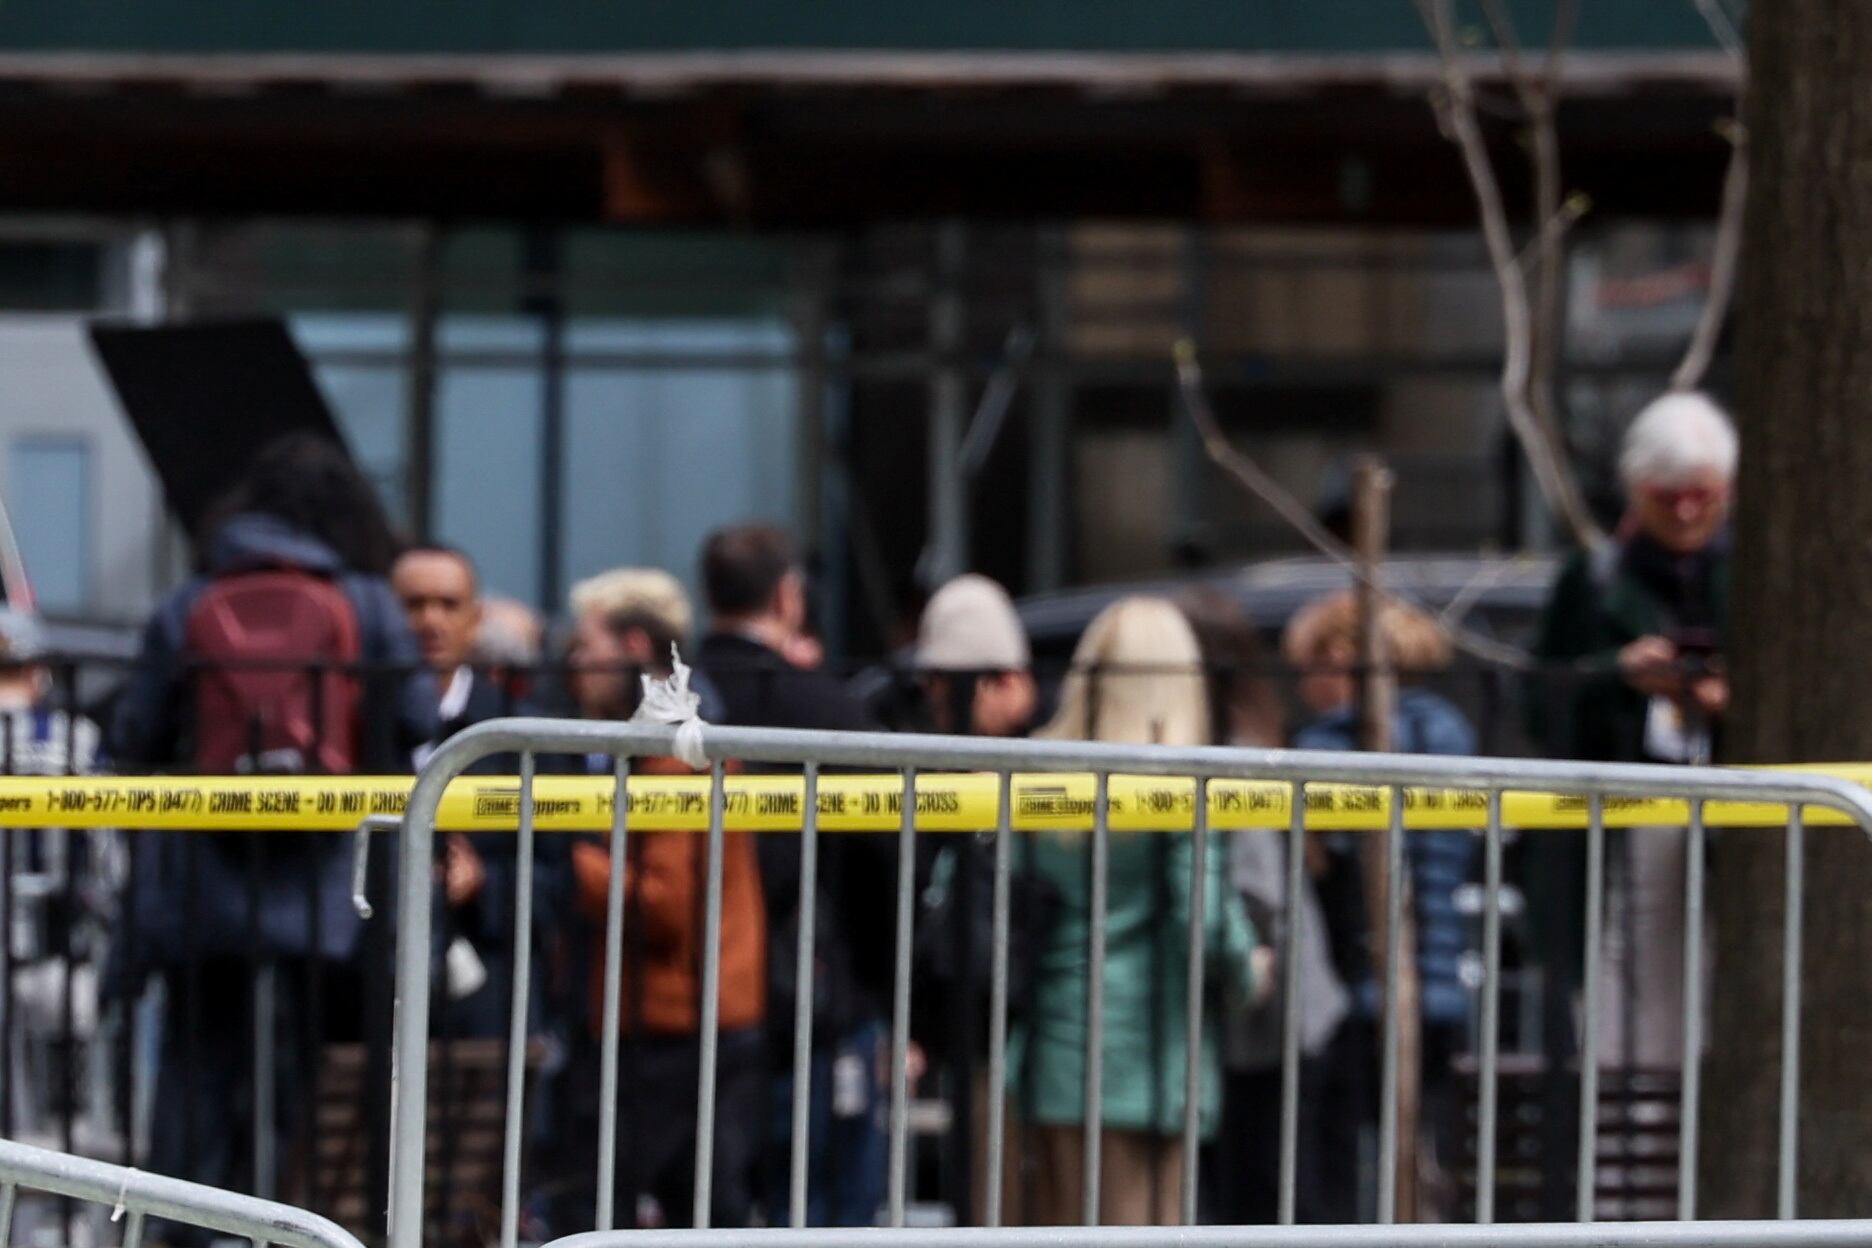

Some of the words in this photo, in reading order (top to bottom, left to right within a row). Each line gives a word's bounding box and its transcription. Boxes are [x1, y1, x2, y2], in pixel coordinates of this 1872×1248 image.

[47, 789, 156, 812] 1-800-577-TIPS
[159, 787, 203, 814] (8477)
[209, 791, 252, 813] CRIME
[257, 791, 300, 813] SCENE
[317, 791, 335, 813] DO
[339, 791, 365, 813] NOT
[370, 791, 412, 813] CROS
[756, 792, 799, 815] CRIME
[862, 792, 880, 814] DO
[884, 792, 904, 814] NO
[915, 791, 959, 814] CROSS
